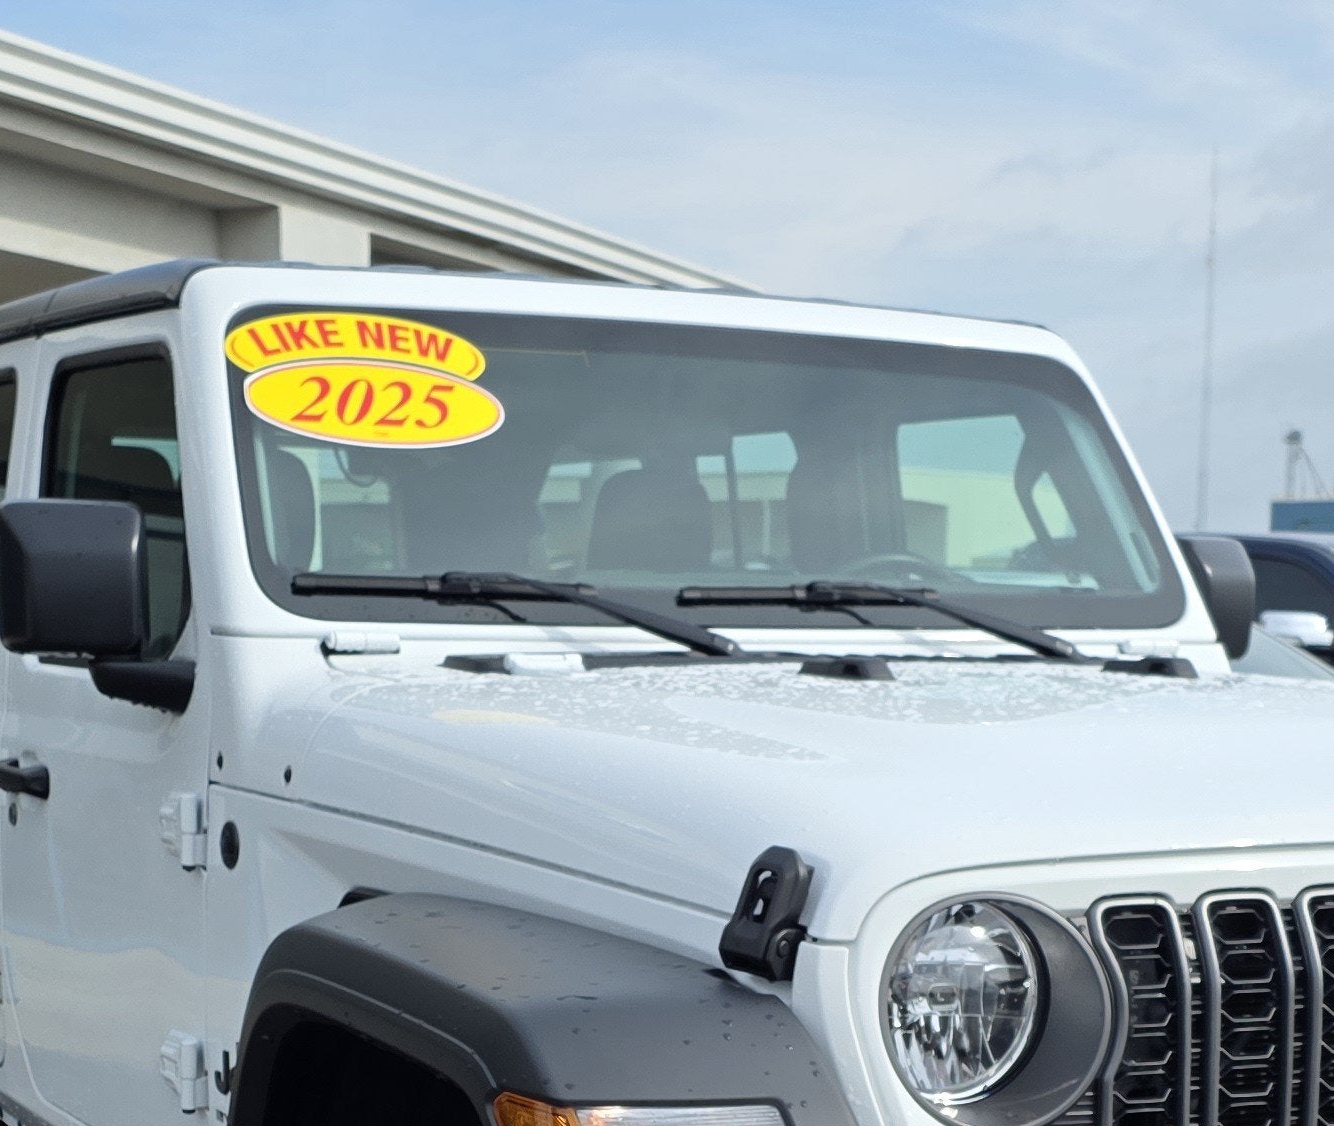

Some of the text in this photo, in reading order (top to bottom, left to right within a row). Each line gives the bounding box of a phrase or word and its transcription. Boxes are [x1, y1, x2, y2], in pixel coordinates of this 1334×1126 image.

[247, 319, 453, 363] LIKE NEW
[290, 376, 455, 428] 2025
